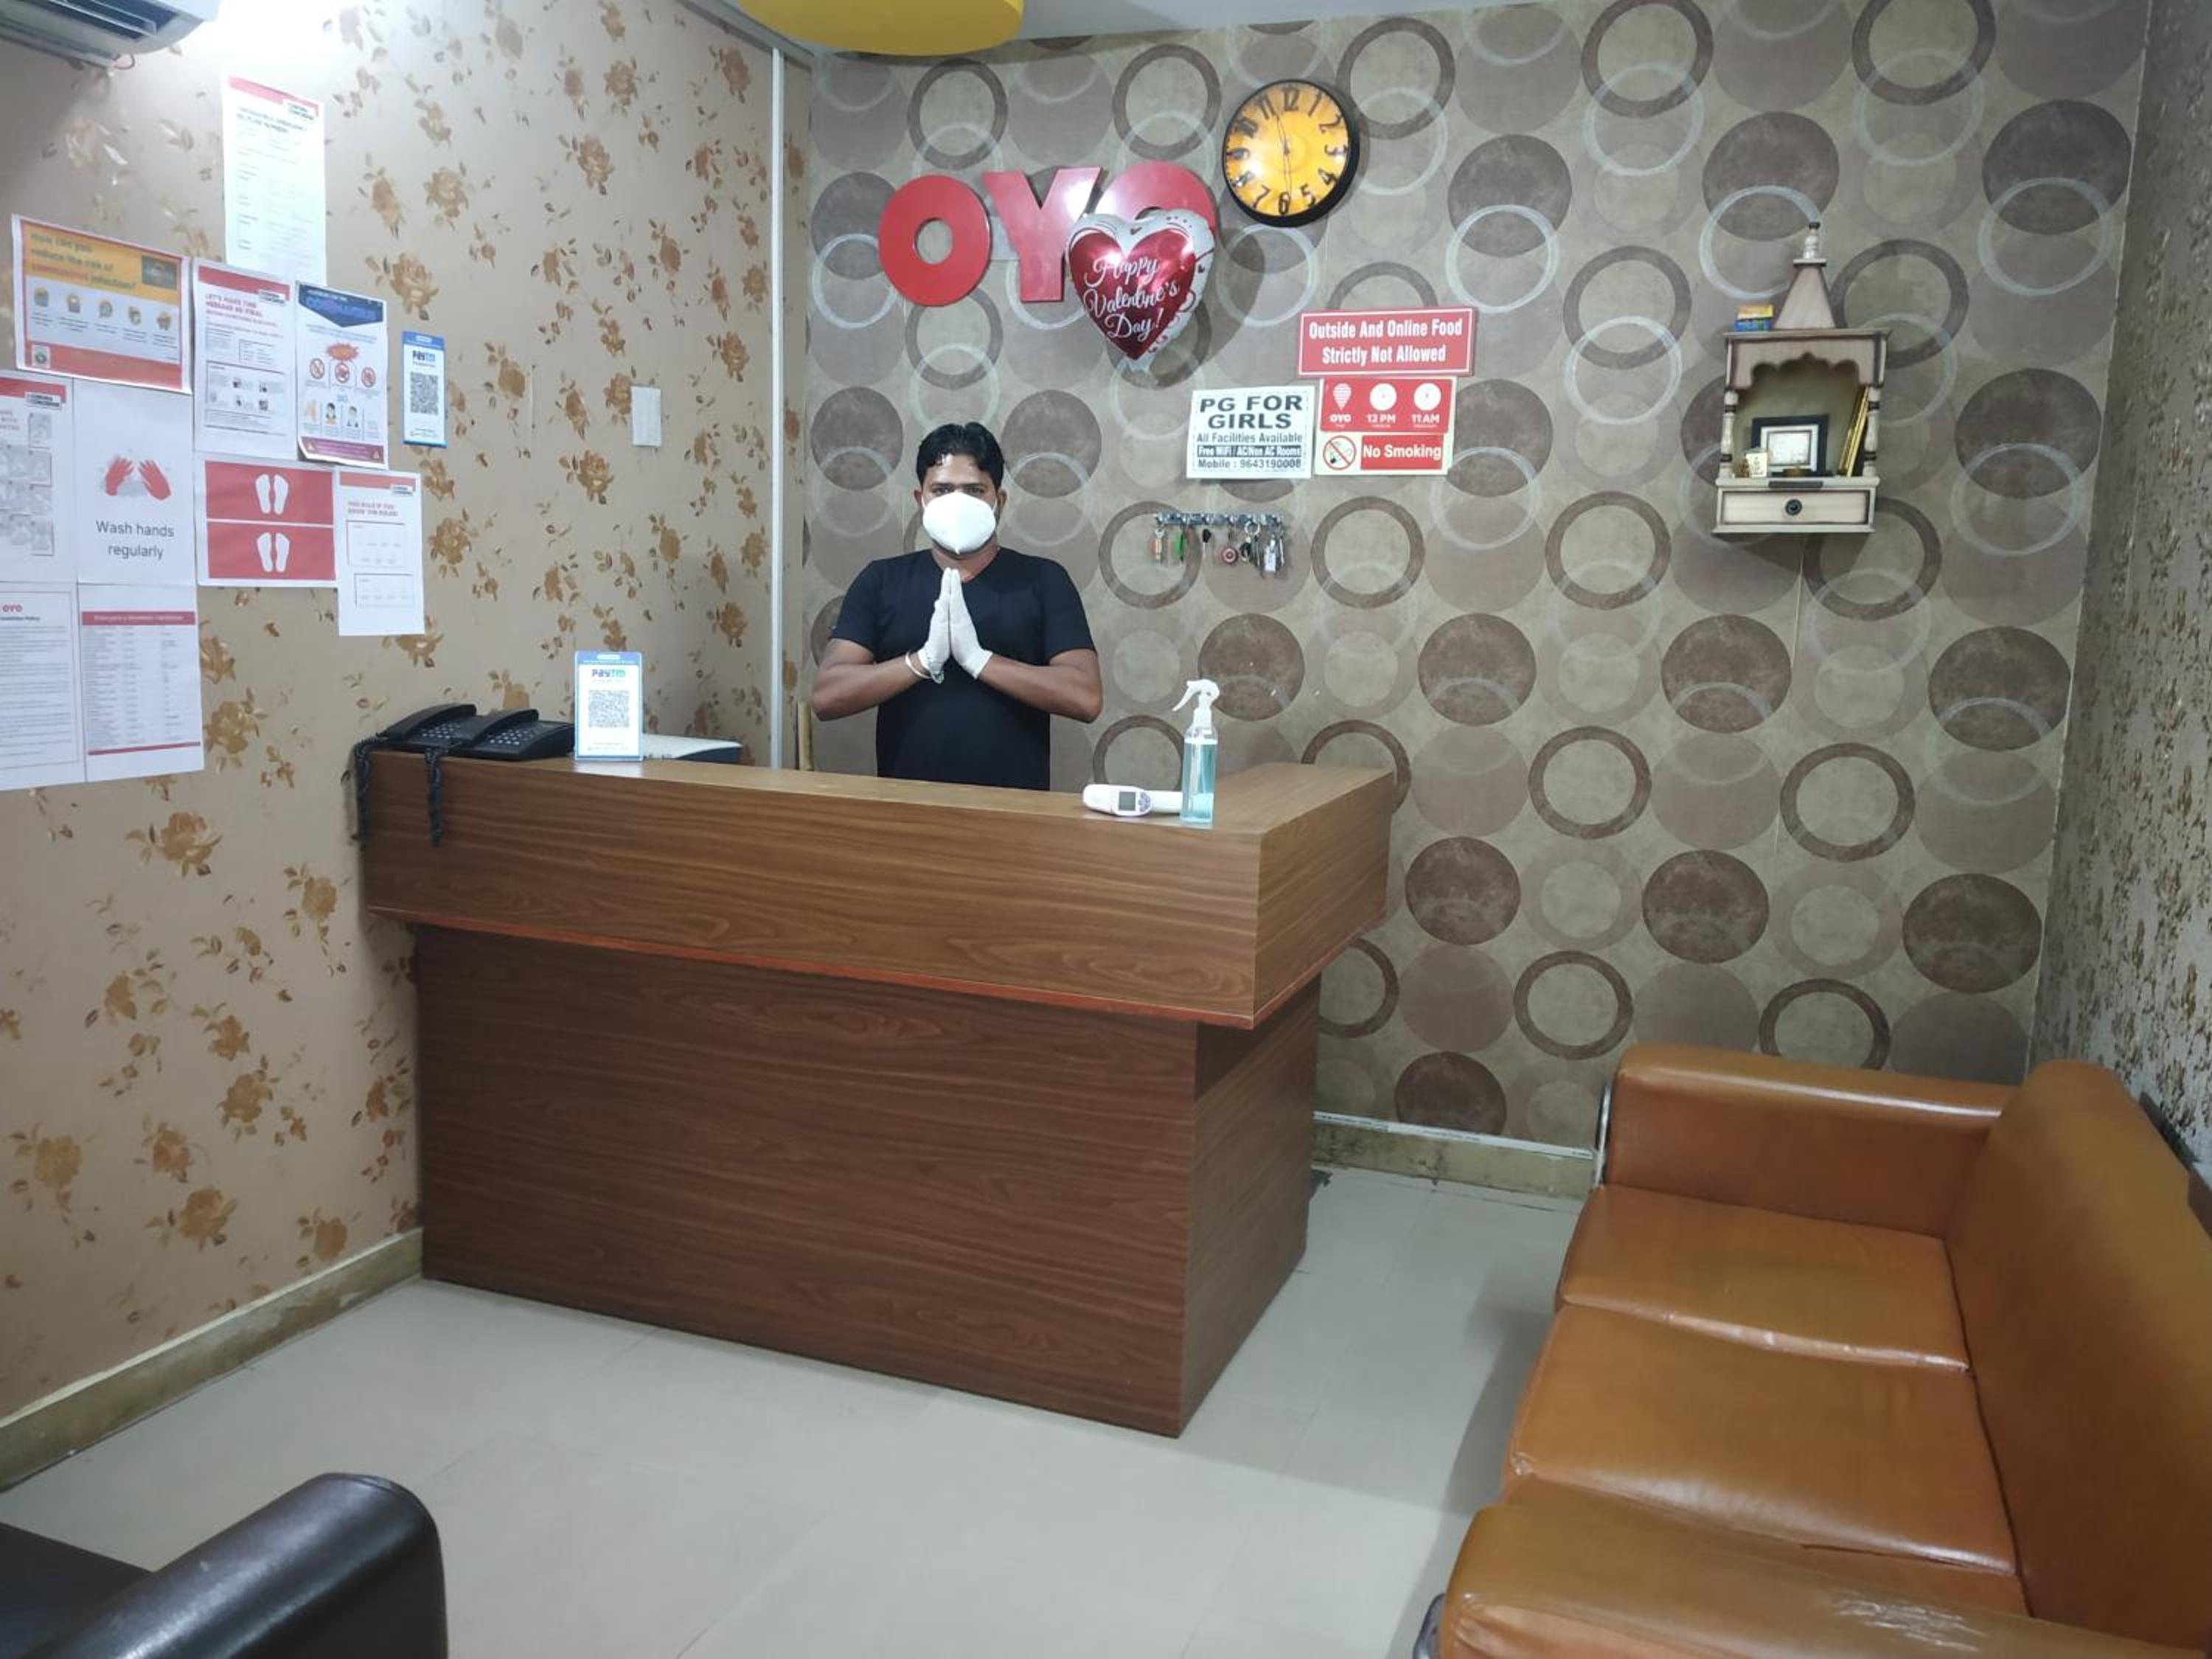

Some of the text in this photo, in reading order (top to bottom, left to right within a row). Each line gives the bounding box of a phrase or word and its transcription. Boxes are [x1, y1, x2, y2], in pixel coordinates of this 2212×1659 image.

[1257, 94, 1276, 120] 11
[1283, 88, 1299, 111] 12
[1308, 93, 1323, 118] 1
[1319, 114, 1343, 134] 2
[1324, 143, 1349, 156] 3
[1318, 168, 1339, 186] 4
[1252, 184, 1271, 209] 7
[1278, 191, 1291, 215] 6
[1300, 183, 1317, 207] 5
[1084, 255, 1160, 288] Happy
[1083, 280, 1180, 318] Valentine's
[1105, 307, 1164, 342] Day!
[1309, 318, 1463, 339] Outside And Online Food
[1322, 344, 1447, 366] Strictly Not Allowed
[1200, 394, 1303, 413] PG FOR
[1207, 413, 1292, 429] GIRLS
[1329, 414, 1352, 423] OYO
[1368, 414, 1397, 423] 12 PM
[1412, 414, 1441, 423] 11 AM
[1197, 432, 1303, 443] All Facilities Available
[1363, 443, 1441, 460] No Smoking
[1197, 458, 1231, 468] Mobile
[95, 519, 175, 538] Wash hands
[108, 544, 164, 561] regularly
[2, 604, 23, 613] OYO
